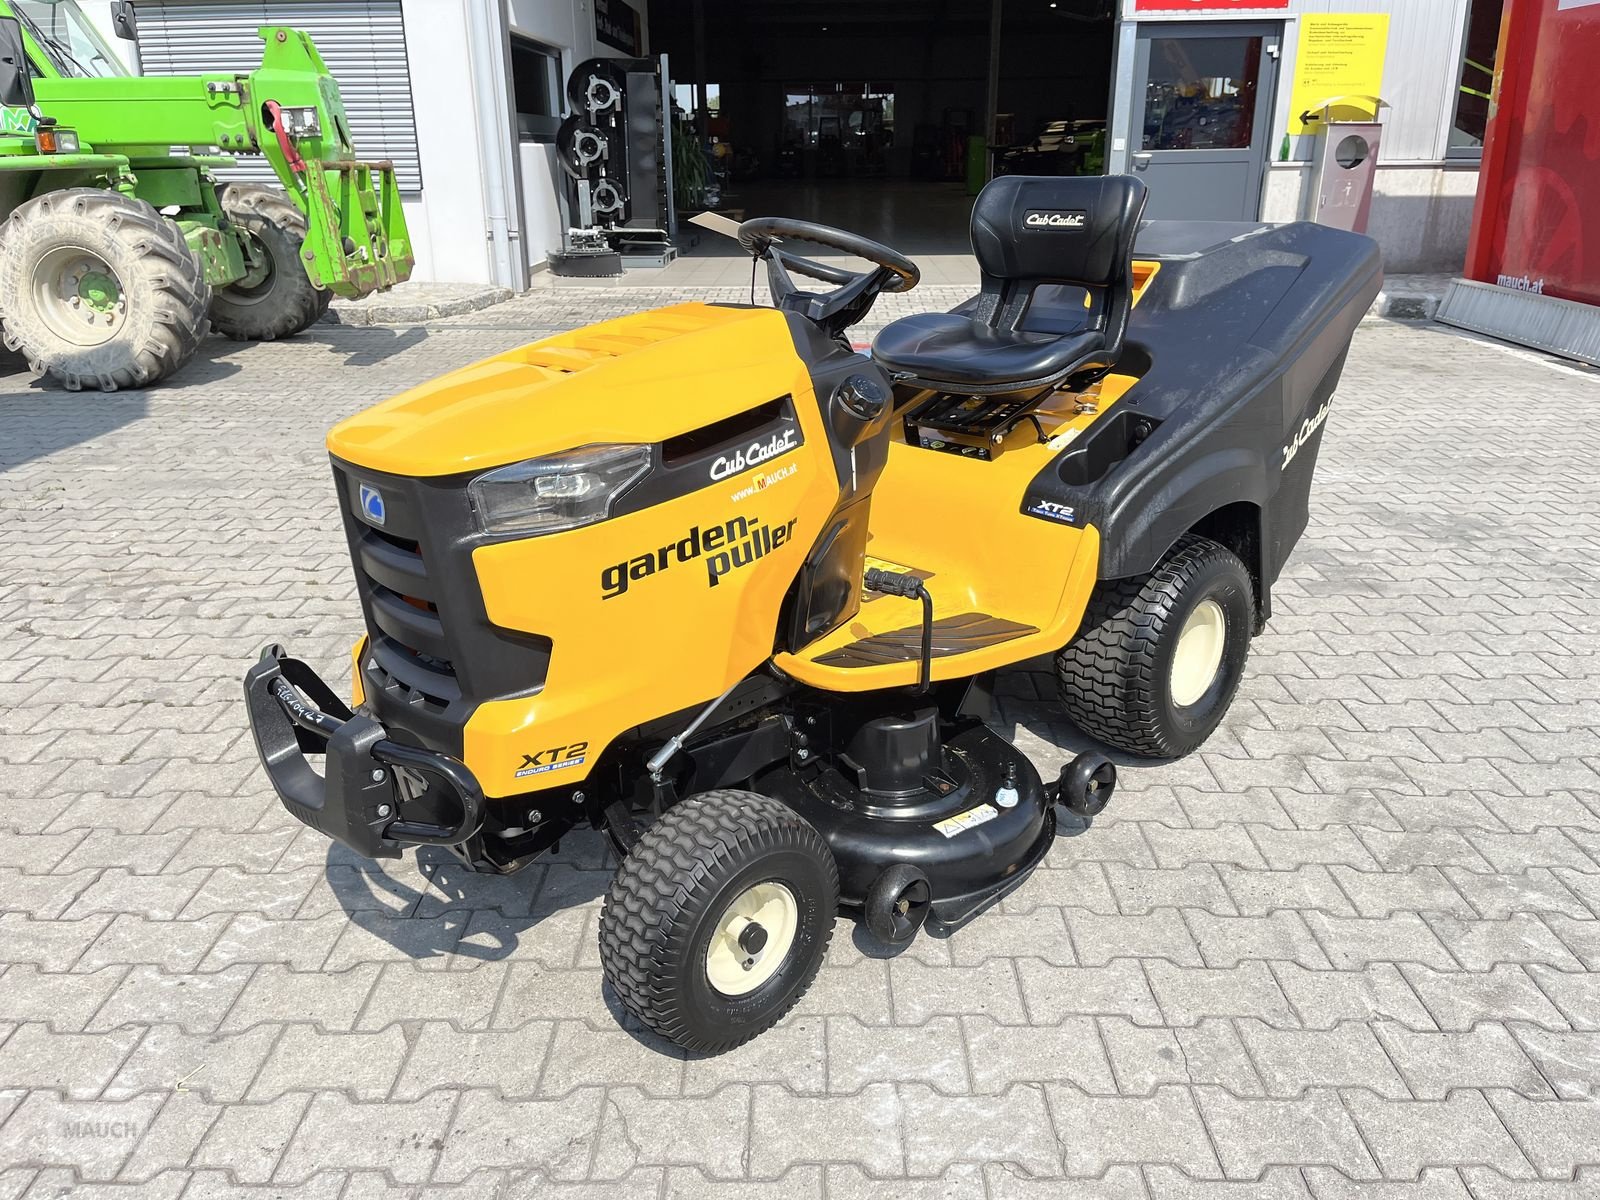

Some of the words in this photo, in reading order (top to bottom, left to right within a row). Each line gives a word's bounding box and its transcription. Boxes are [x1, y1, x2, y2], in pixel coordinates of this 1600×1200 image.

[1026, 213, 1049, 226] Cub
[1049, 214, 1085, 226] Cadet
[1496, 274, 1545, 295] mauch.at
[709, 450, 746, 481] Cub
[745, 428, 798, 466] Cadet
[730, 462, 798, 503] www.MAUCH.at
[1037, 500, 1075, 517] XT2
[601, 515, 759, 601] garden-
[706, 517, 798, 588] puller
[515, 765, 551, 778] ENDURO
[551, 758, 582, 770] SERIES
[516, 741, 589, 770] XT2
